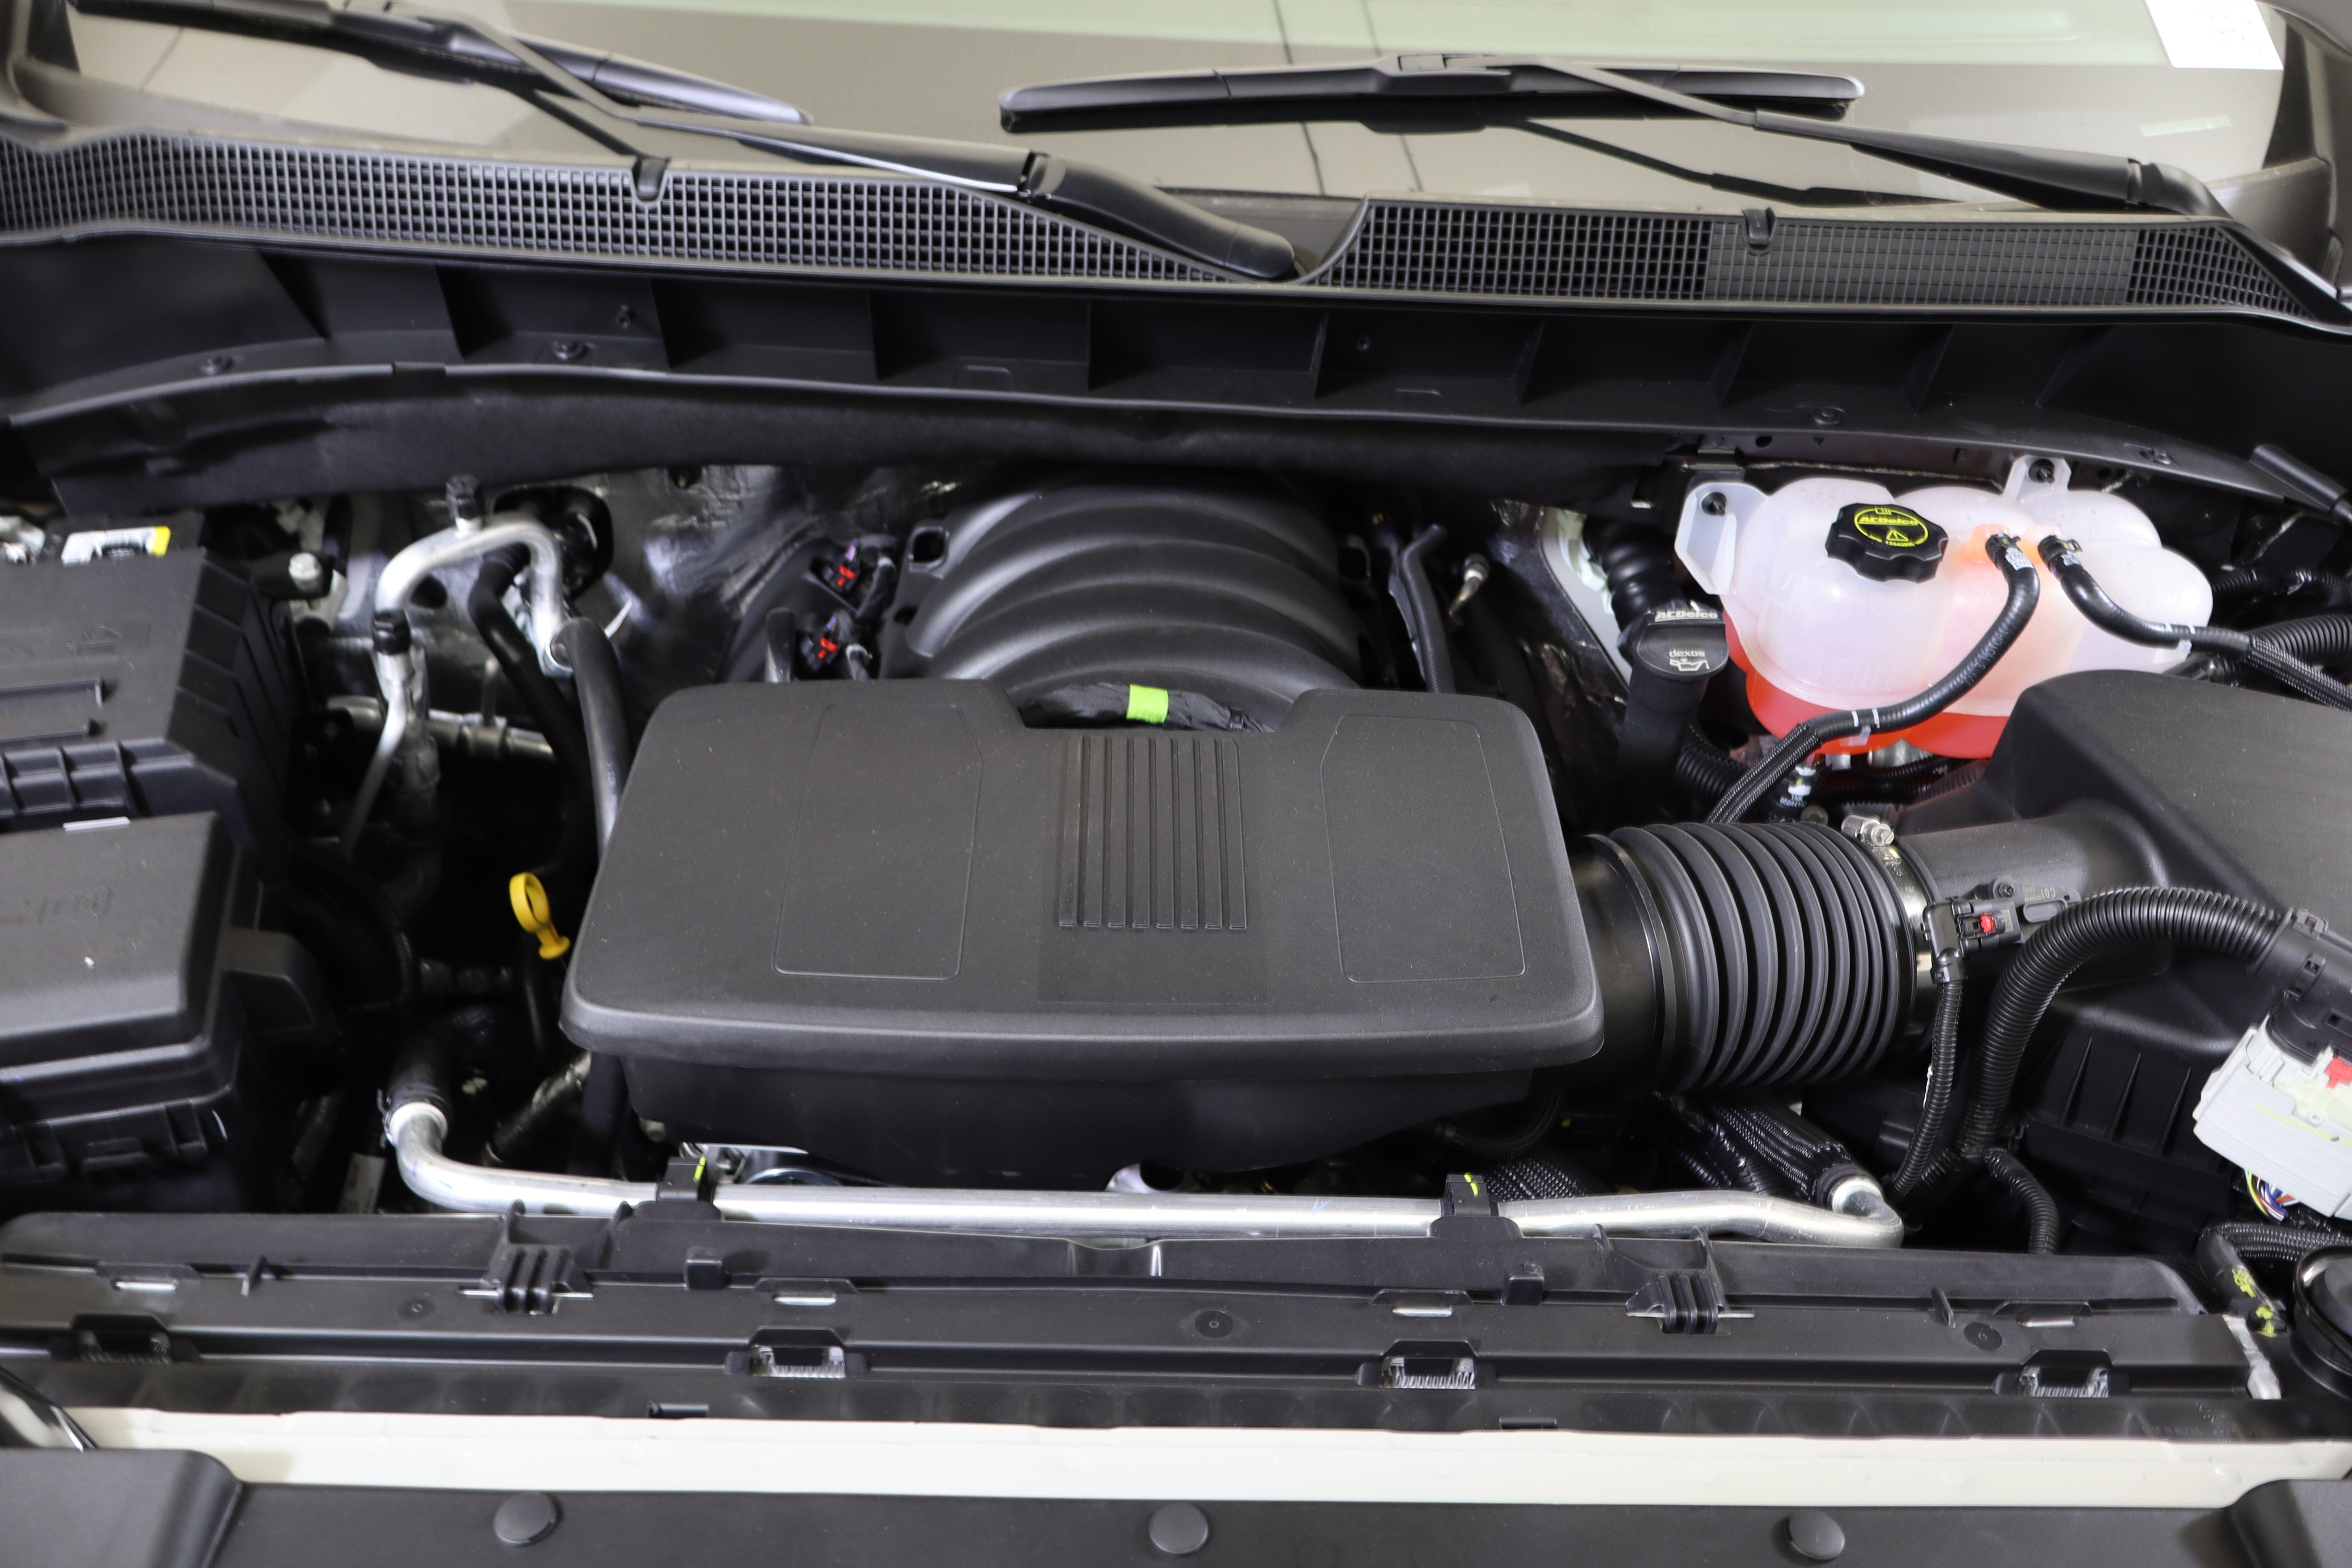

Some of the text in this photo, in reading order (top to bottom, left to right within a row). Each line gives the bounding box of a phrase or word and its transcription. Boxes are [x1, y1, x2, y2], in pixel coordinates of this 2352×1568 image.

[1858, 517, 1919, 526] ACDelco
[1655, 610, 1719, 621] ACDelco
[1669, 648, 1706, 657] dexos
